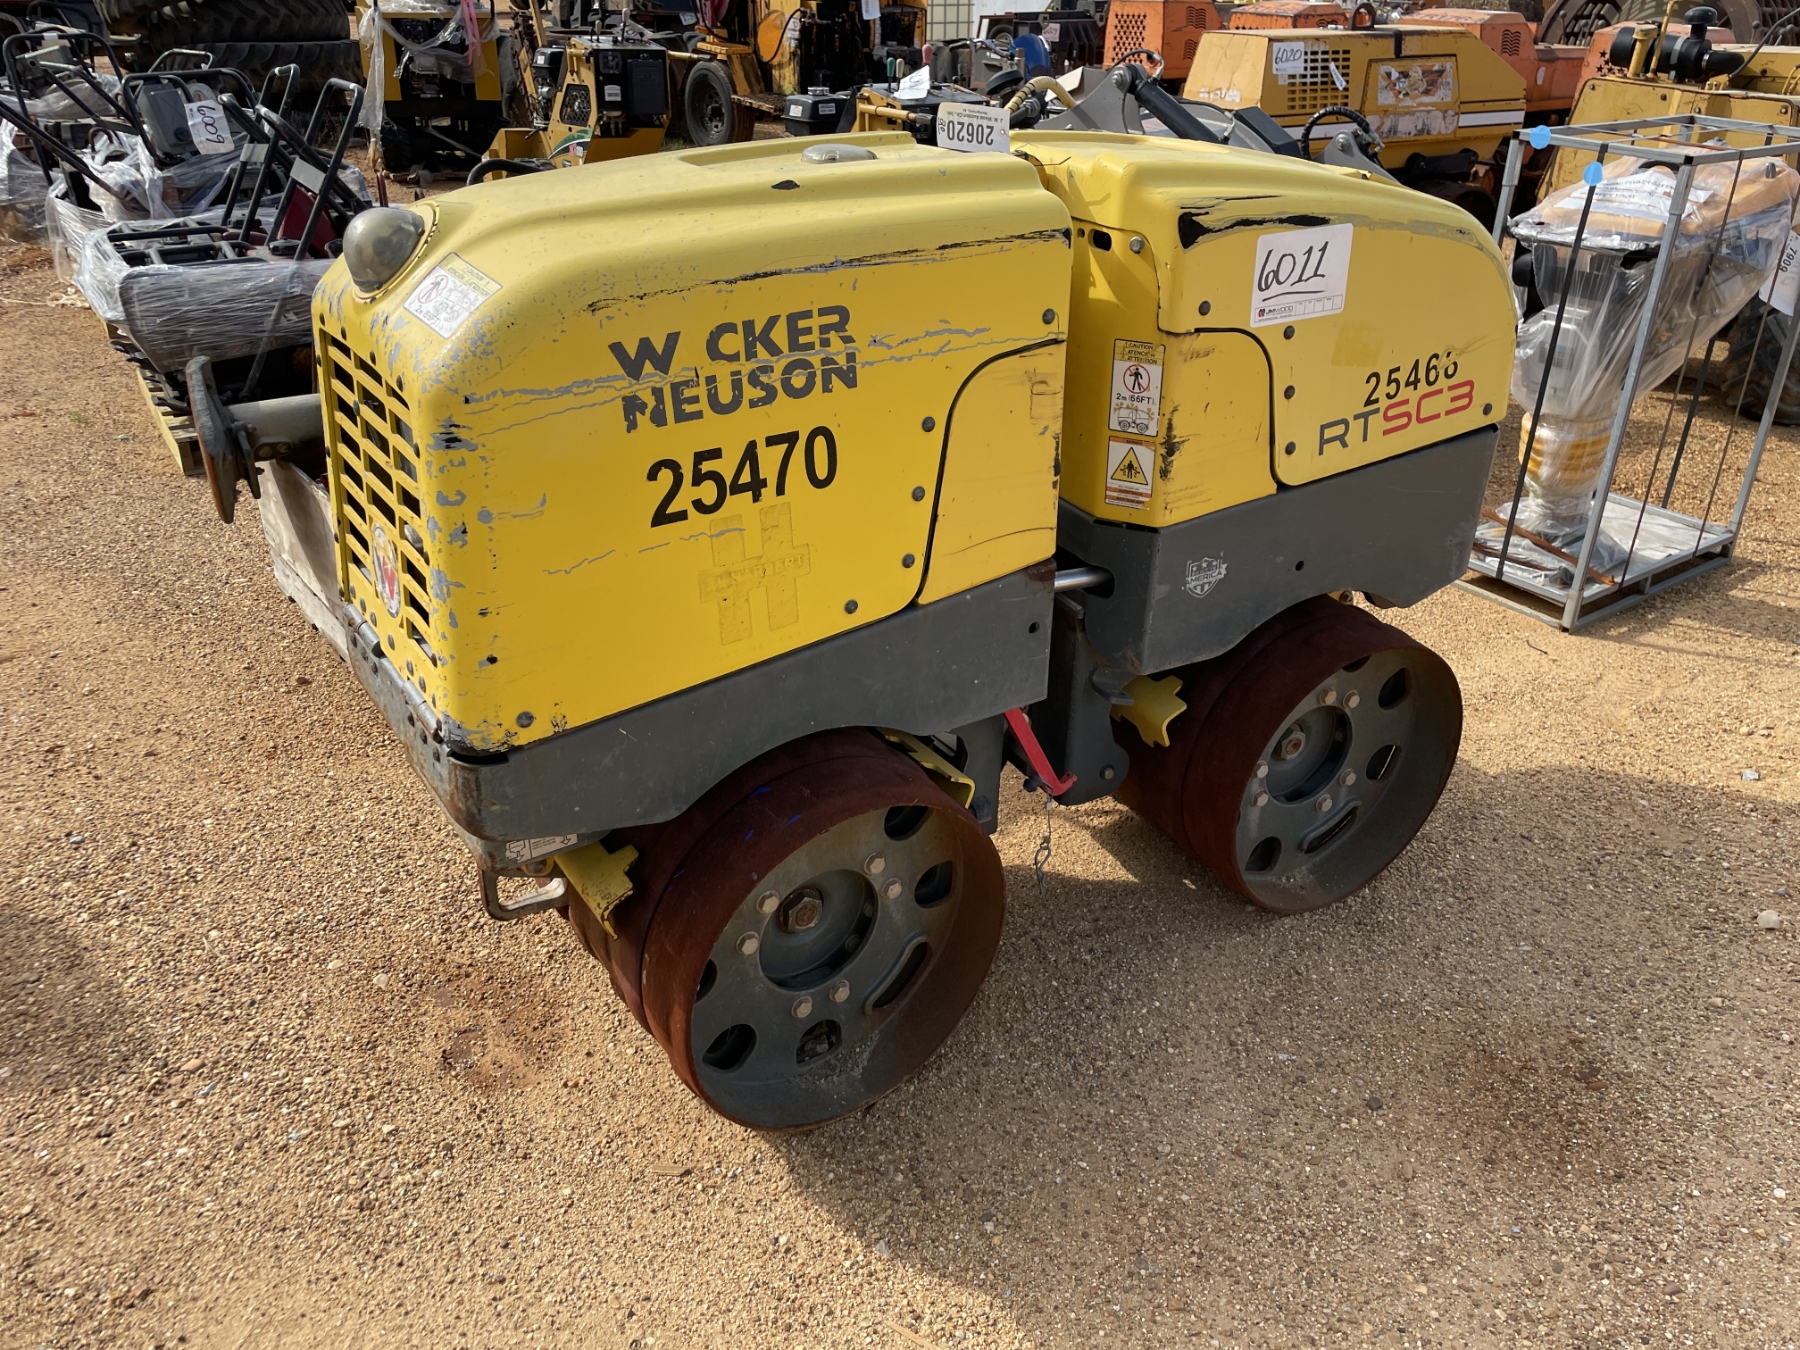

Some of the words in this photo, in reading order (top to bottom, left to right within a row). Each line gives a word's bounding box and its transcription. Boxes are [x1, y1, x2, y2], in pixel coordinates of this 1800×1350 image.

[1274, 46, 1303, 65] 6020
[196, 105, 225, 144] 6009
[946, 120, 995, 146] 20620
[1257, 240, 1329, 292] 6011
[1779, 247, 1798, 273] 7909
[607, 304, 857, 382] WCKER
[1128, 342, 1154, 350] CAUTION
[621, 350, 858, 434] NEUSON
[646, 425, 838, 528] 25470
